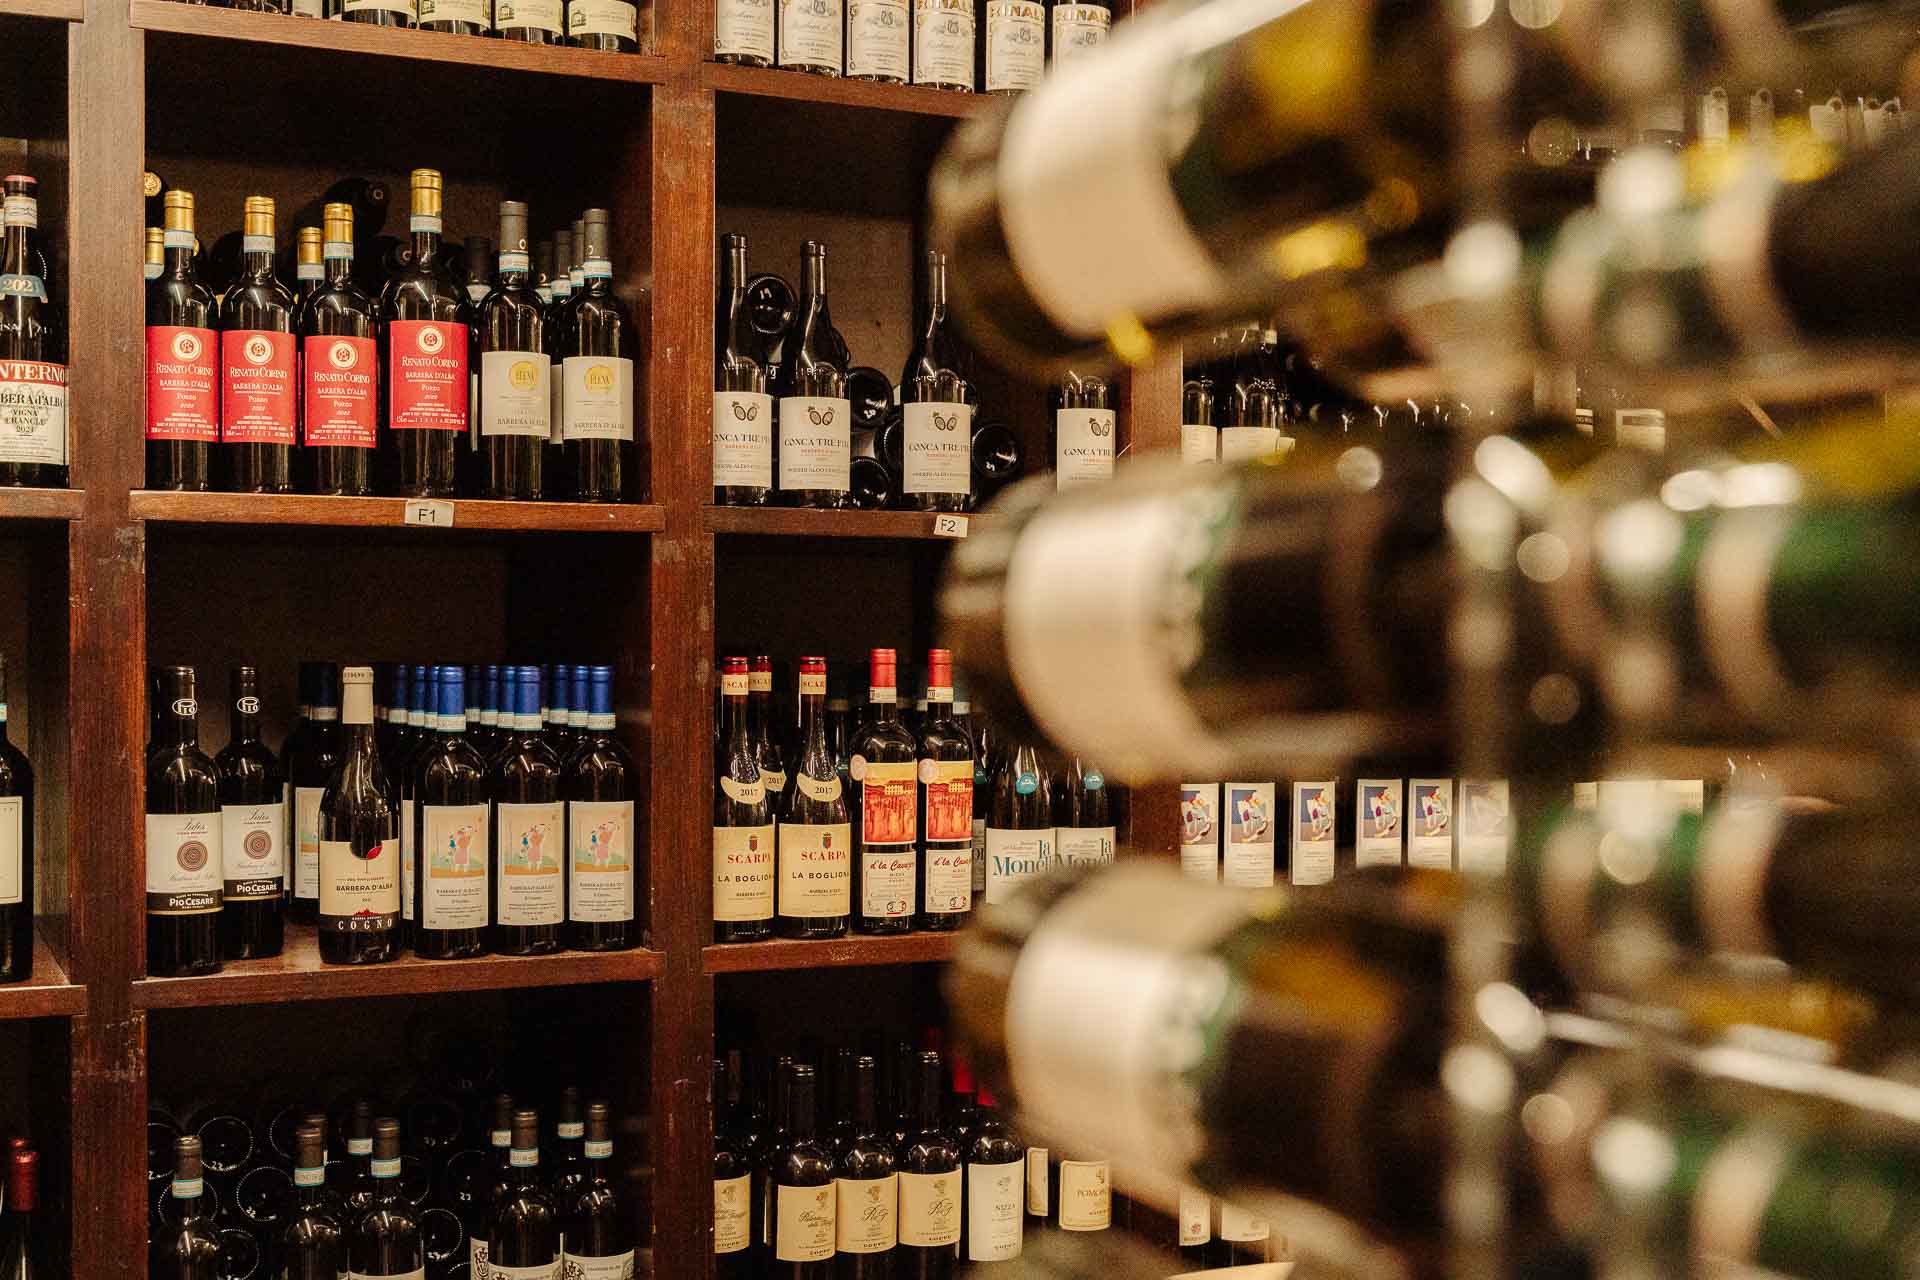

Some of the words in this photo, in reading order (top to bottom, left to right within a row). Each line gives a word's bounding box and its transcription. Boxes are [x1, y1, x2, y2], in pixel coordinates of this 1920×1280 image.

[418, 508, 436, 523] F1
[940, 518, 957, 533] F2
[740, 788, 758, 796] 2017
[815, 786, 833, 794] 2017
[718, 875, 730, 883] LA
[236, 884, 251, 893] PIO
[251, 883, 278, 893] CESARE
[336, 884, 370, 892] BARBERA
[169, 898, 185, 907] PIO
[185, 897, 214, 907] CESARE
[338, 918, 393, 931] COGNO
